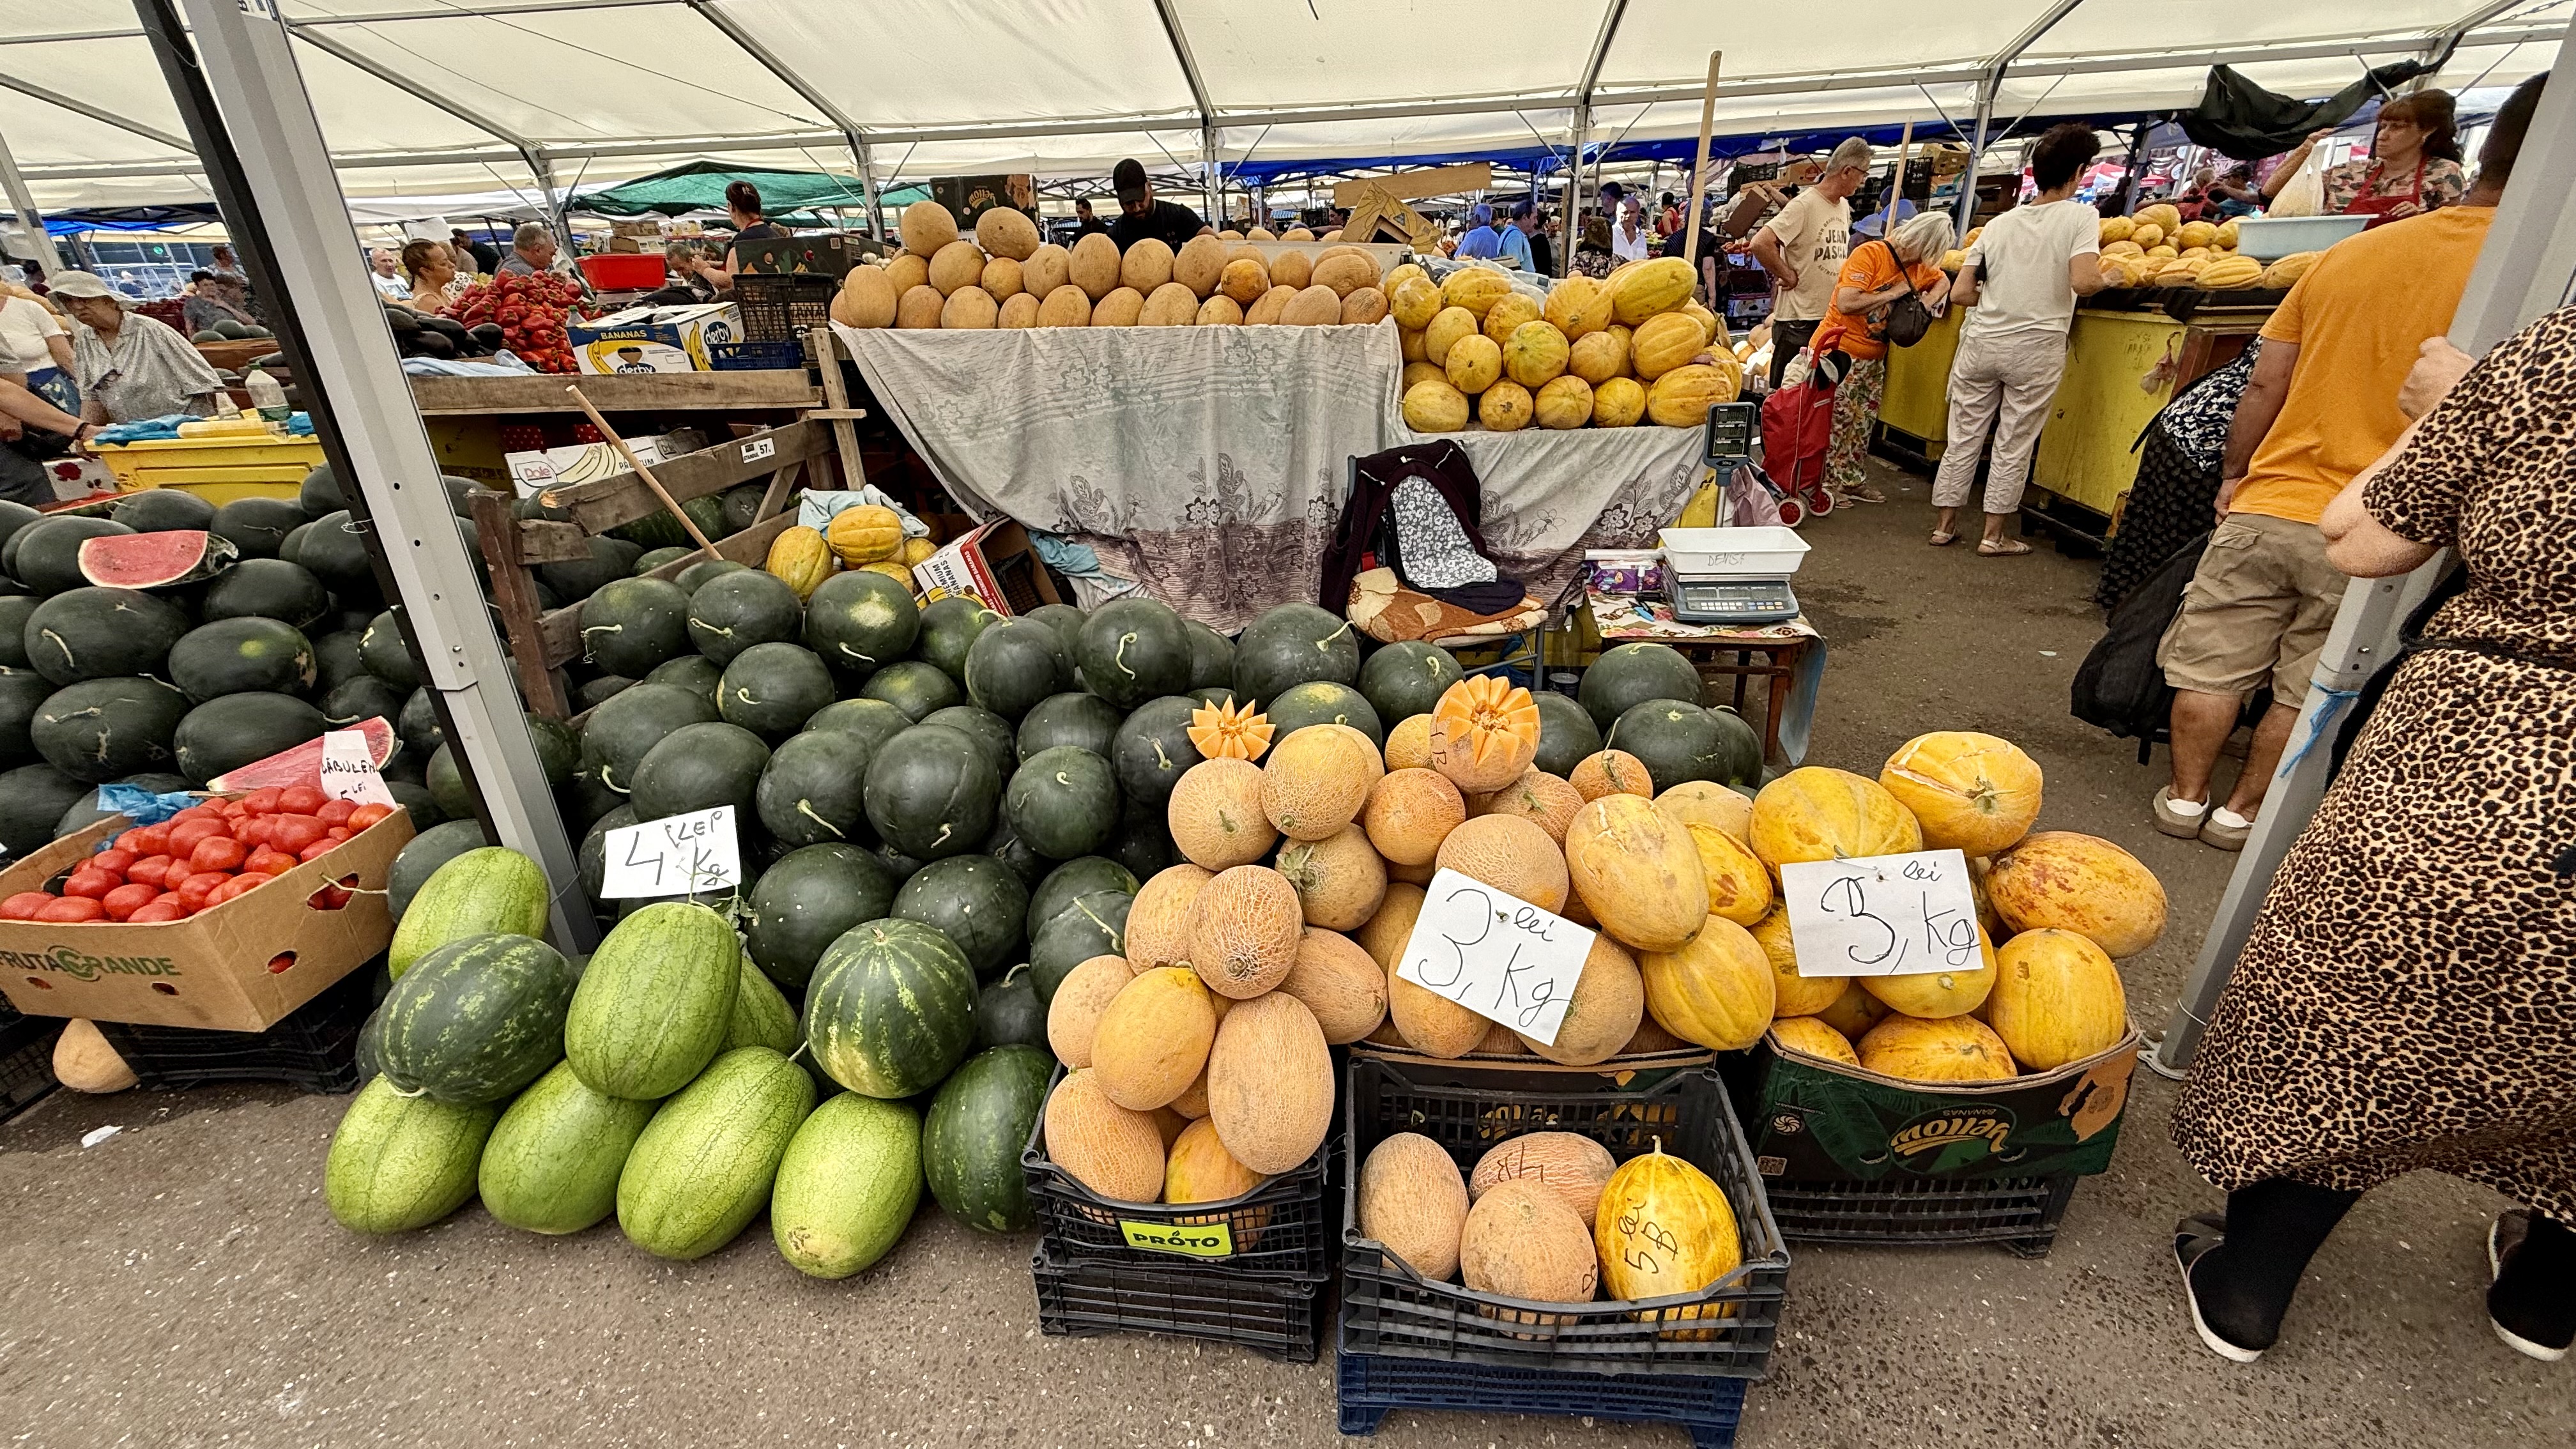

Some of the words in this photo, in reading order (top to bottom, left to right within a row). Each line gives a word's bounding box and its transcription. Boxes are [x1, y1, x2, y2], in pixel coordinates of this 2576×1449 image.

[1825, 229, 1847, 244] JEAN
[1813, 245, 1848, 262] PASCA
[601, 330, 647, 341] BANANAS
[705, 325, 730, 344] derby
[618, 457, 654, 470] PRUM
[523, 466, 552, 479] Dole
[940, 560, 963, 596] BANANAS
[625, 831, 664, 885] 4
[1514, 907, 1554, 942] lei
[1942, 1108, 1997, 1117] BANANAS
[1890, 1117, 2010, 1153] yellow
